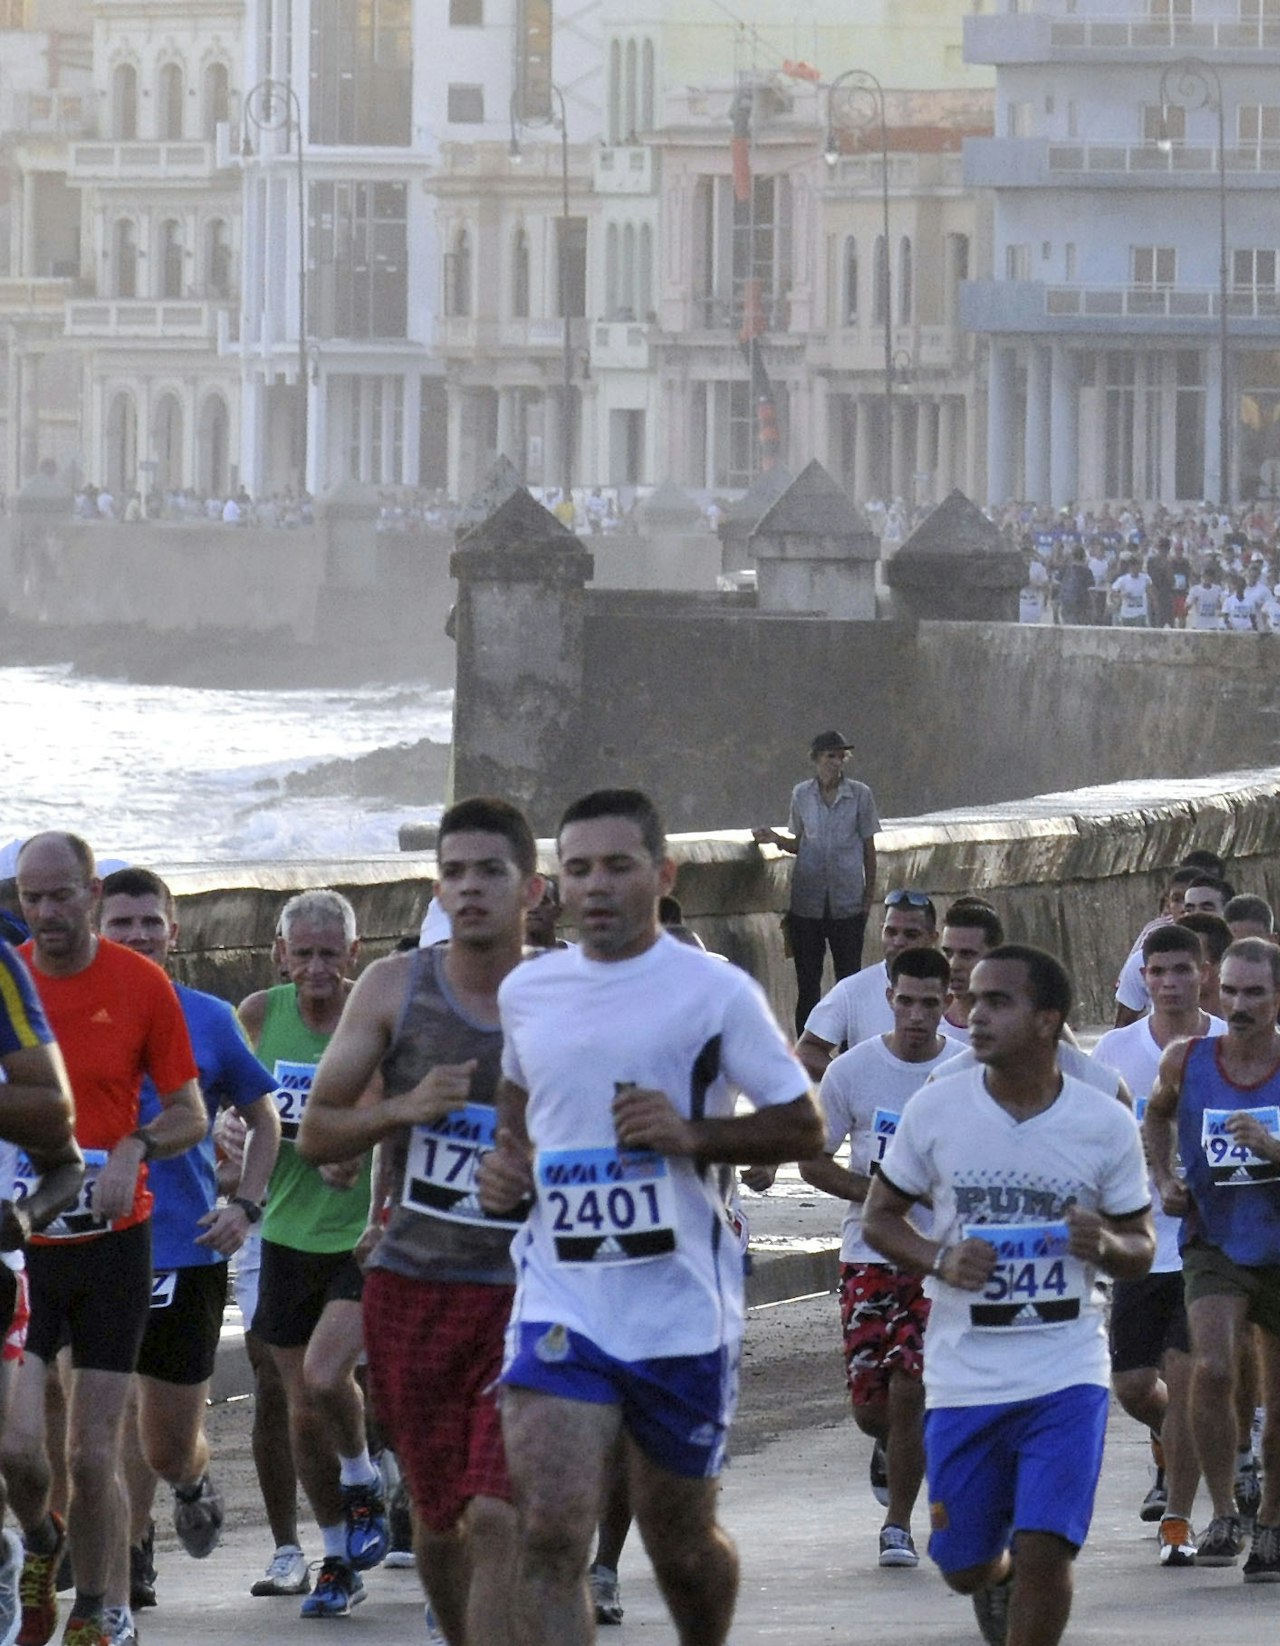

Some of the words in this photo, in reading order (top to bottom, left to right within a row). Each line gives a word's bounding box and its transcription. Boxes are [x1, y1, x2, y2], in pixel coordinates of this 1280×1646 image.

[422, 1139, 484, 1183] 17
[1210, 1137, 1257, 1163] 94
[548, 1184, 661, 1231] 2401
[983, 1261, 1067, 1301] 544
